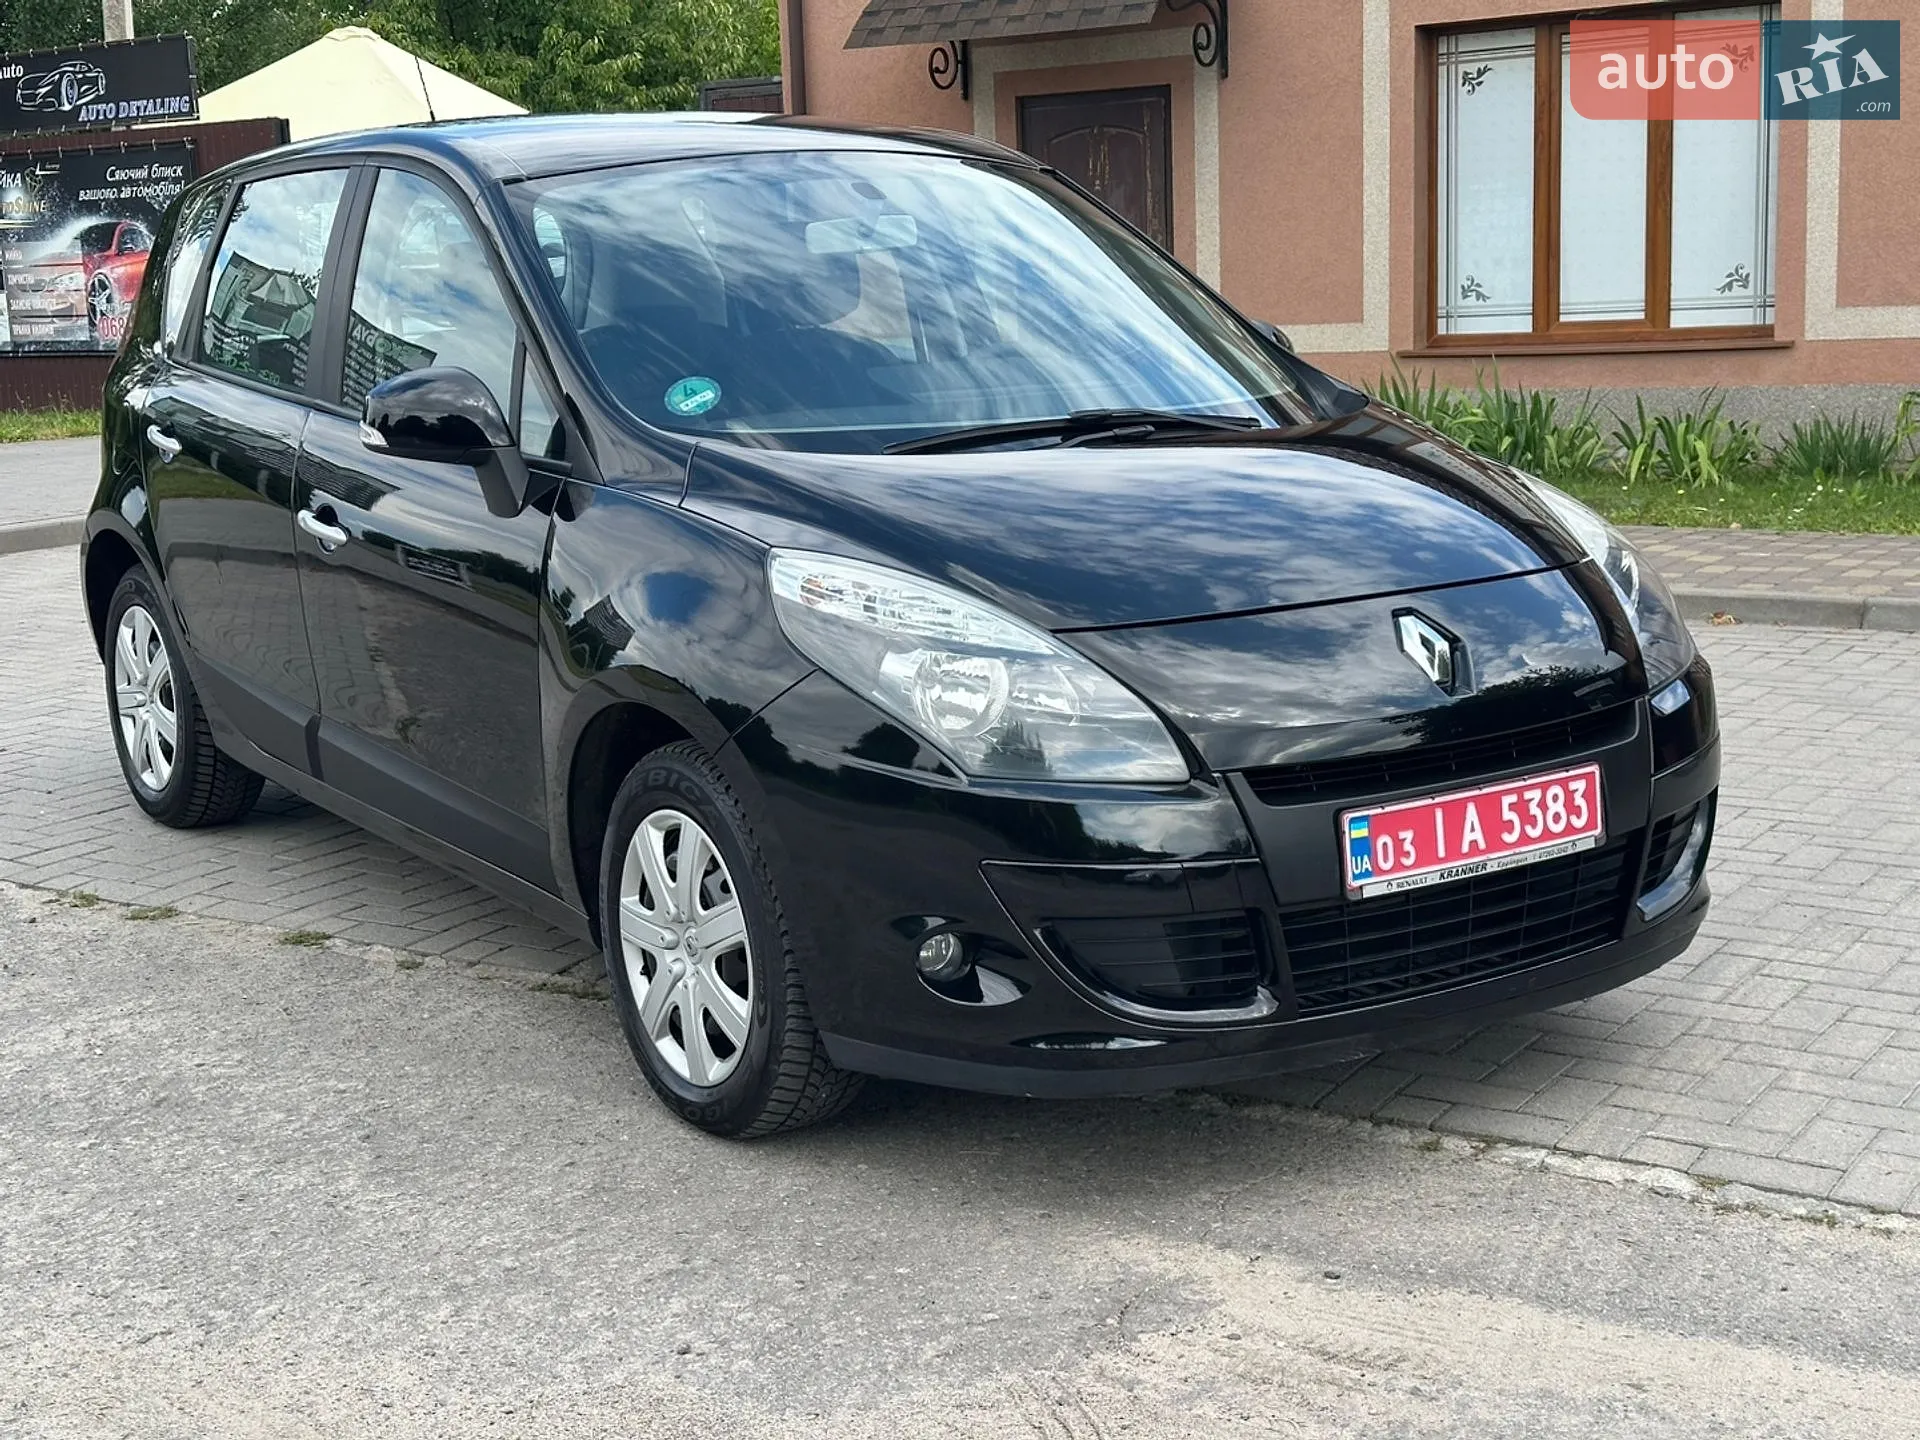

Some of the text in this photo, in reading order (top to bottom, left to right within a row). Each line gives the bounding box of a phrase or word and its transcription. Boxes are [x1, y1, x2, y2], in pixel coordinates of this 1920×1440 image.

[78, 96, 190, 121] AUTO DETALING
[106, 163, 184, 181] Сяючий блиск
[1376, 779, 1588, 872] 03 IA 5383
[1351, 856, 1372, 874] UA
[1396, 877, 1428, 889] RENAULT
[1439, 863, 1488, 881] KRANNER
